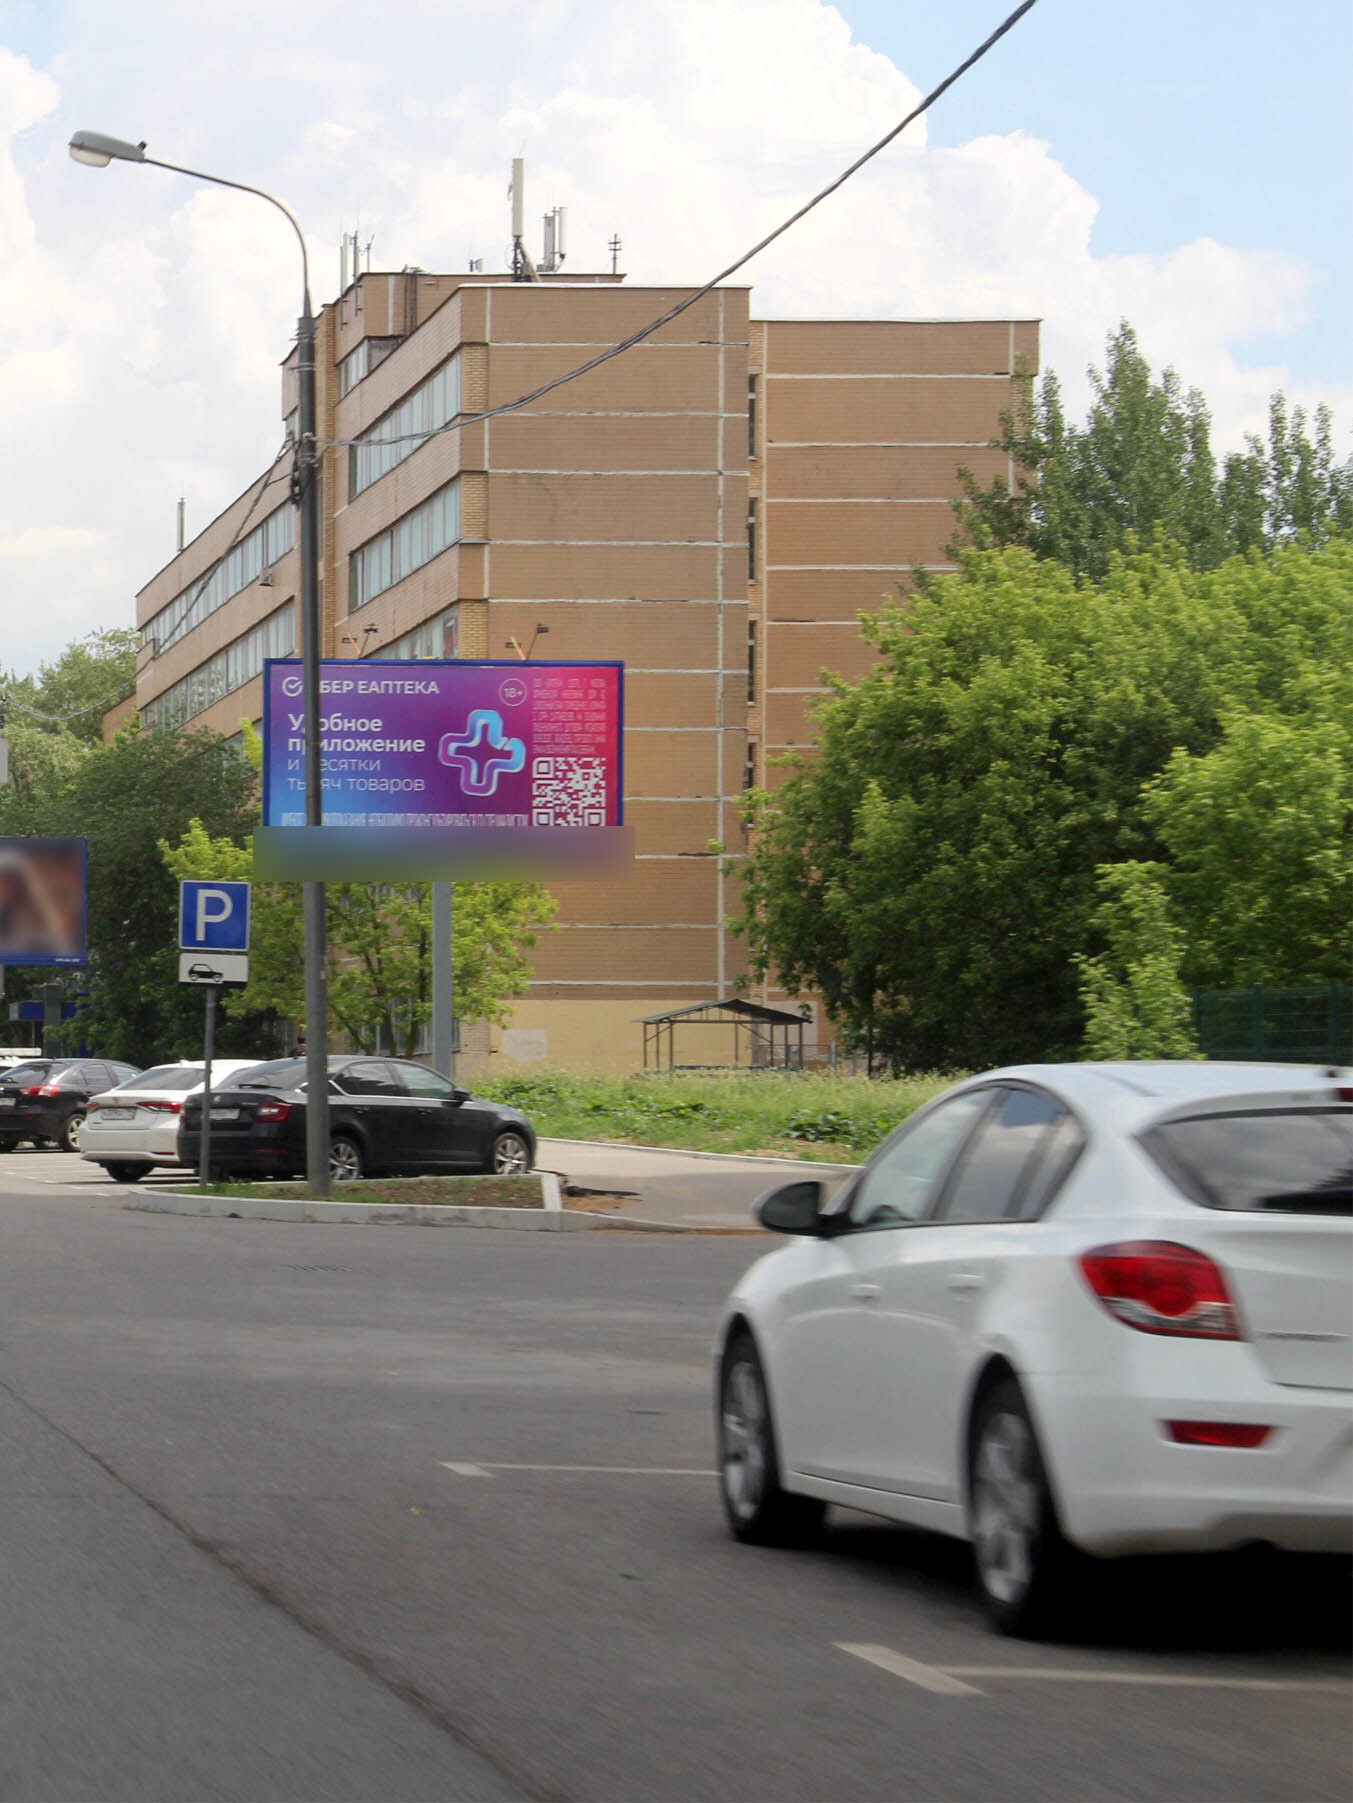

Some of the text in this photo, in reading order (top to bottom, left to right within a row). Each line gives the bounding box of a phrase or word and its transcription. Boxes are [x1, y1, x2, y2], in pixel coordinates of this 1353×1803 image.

[319, 681, 440, 694] БЕР ЕАПТЕКА
[288, 713, 383, 733] Уобное
[288, 738, 425, 755] пиложение
[288, 759, 381, 772] и есятки
[347, 778, 425, 794] товаров
[196, 888, 233, 941] P
